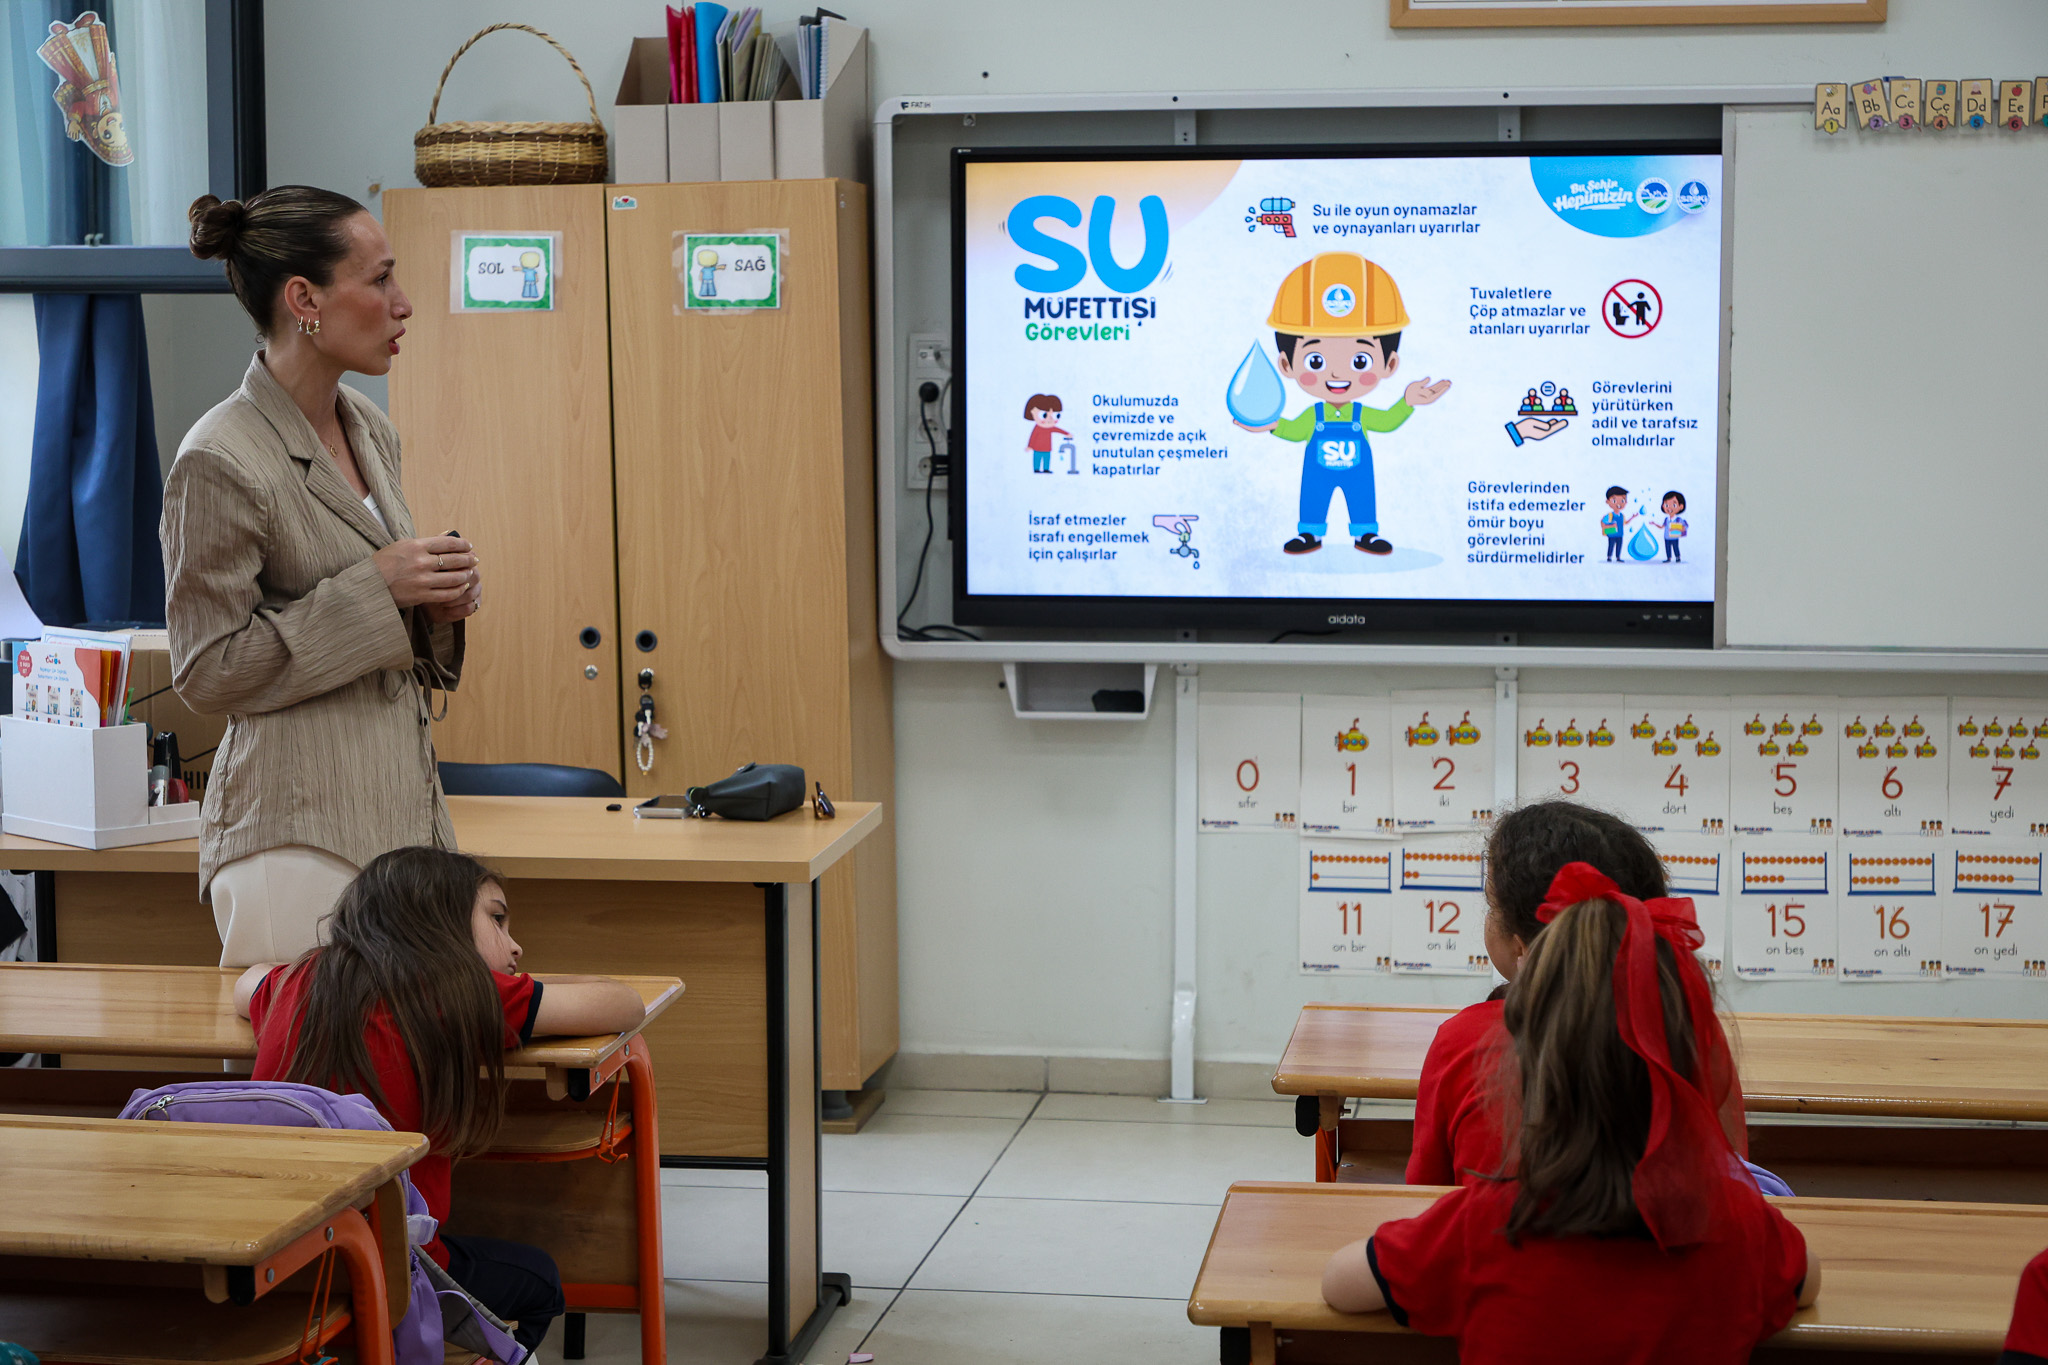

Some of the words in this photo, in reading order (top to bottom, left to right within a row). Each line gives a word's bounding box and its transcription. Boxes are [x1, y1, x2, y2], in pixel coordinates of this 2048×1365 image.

[1821, 101, 1840, 115] Aa
[1862, 99, 1881, 114] Bb
[1895, 95, 1914, 109] Cc
[1930, 97, 1950, 114] Çç
[1967, 98, 1986, 112] Dd
[2008, 99, 2024, 113] Ee
[1829, 122, 1834, 130] 1
[1873, 119, 1881, 127] 2
[1903, 118, 1909, 126] 3
[1936, 119, 1944, 128] 4
[1973, 118, 1981, 127] 5
[2012, 119, 2019, 129] 6
[1552, 187, 1634, 212] Hepimizin
[1313, 204, 1330, 216] Su
[1335, 204, 1351, 216] ile
[1355, 205, 1389, 219] oyun
[1394, 204, 1477, 218] oynamazlar
[1313, 224, 1329, 234] ve
[1333, 222, 1415, 237] oynayanları
[1420, 221, 1480, 236] uyarırlar
[1007, 195, 1169, 293] SU
[478, 262, 504, 275] SOL
[734, 257, 766, 272] SAĞ
[1470, 287, 1552, 299] Tuvaletlere
[1025, 297, 1156, 326] MÜFETTİŞİ
[1470, 304, 1497, 320] Çöp
[1502, 304, 1565, 317] atmazlar
[1570, 306, 1586, 316] ve
[1026, 323, 1130, 340] Görevleri
[1470, 323, 1525, 334] atanları
[1529, 323, 1590, 337] uyarırlar
[1592, 381, 1672, 393] Görevlerini
[1092, 395, 1179, 407] Okulumuzda
[1592, 399, 1673, 413] yürütürken
[1093, 412, 1154, 424] evimizde
[1160, 414, 1174, 423] ve
[1592, 416, 1618, 429] adil
[1622, 418, 1638, 429] ve
[1642, 416, 1698, 429] tarafsız
[1093, 430, 1174, 444] çevremizde
[1178, 429, 1207, 444] açık
[1592, 434, 1675, 447] olmalıdırlar
[1093, 447, 1154, 458] unutulan
[1158, 446, 1228, 461] çeşmeleri
[1322, 441, 1356, 461] SU
[1093, 464, 1160, 478] kapatırlar
[1468, 481, 1570, 493] Görevlerinden
[1468, 499, 1504, 511] istifa
[1509, 500, 1585, 511] edemezler
[1029, 511, 1061, 525] İsraf
[1065, 514, 1127, 526] etmezler
[1468, 516, 1505, 529] ömür
[1509, 517, 1544, 531] boyu
[1029, 531, 1064, 543] israfı
[1068, 532, 1149, 545] engellemek
[1468, 534, 1545, 549] görevlerini
[1029, 548, 1053, 562] için
[1057, 548, 1117, 562] çalışırlar
[1468, 551, 1585, 563] sürdürmelidirler
[1328, 614, 1366, 625] aidata
[1237, 759, 1260, 792] 0
[1345, 763, 1356, 796] 1
[1433, 758, 1455, 790] 2
[1560, 761, 1580, 794] 3
[1664, 764, 1689, 797] 4
[1775, 764, 1797, 797] 5
[1882, 766, 1903, 800] 6
[1992, 767, 2014, 801] 7
[1343, 801, 1358, 814] bir
[1439, 796, 1450, 807] iki
[1662, 802, 1687, 815] dört
[1773, 802, 1792, 816] beş
[1884, 804, 1901, 818] altı
[1990, 806, 2014, 823] yedi
[1339, 902, 1362, 935] 11
[1425, 899, 1461, 934] 12
[1767, 904, 1806, 938] 15
[1875, 905, 1910, 940] 16
[1980, 904, 2015, 938] 17
[1332, 944, 1346, 953] on
[1352, 941, 1366, 953] bir
[1427, 942, 1441, 951] on
[1446, 939, 1456, 951] iki
[1766, 946, 1780, 955] on
[1785, 942, 1804, 956] beş
[1874, 948, 1888, 957] on
[1894, 944, 1911, 957] altı
[1974, 947, 1988, 955] on
[1994, 943, 2017, 961] yedi
